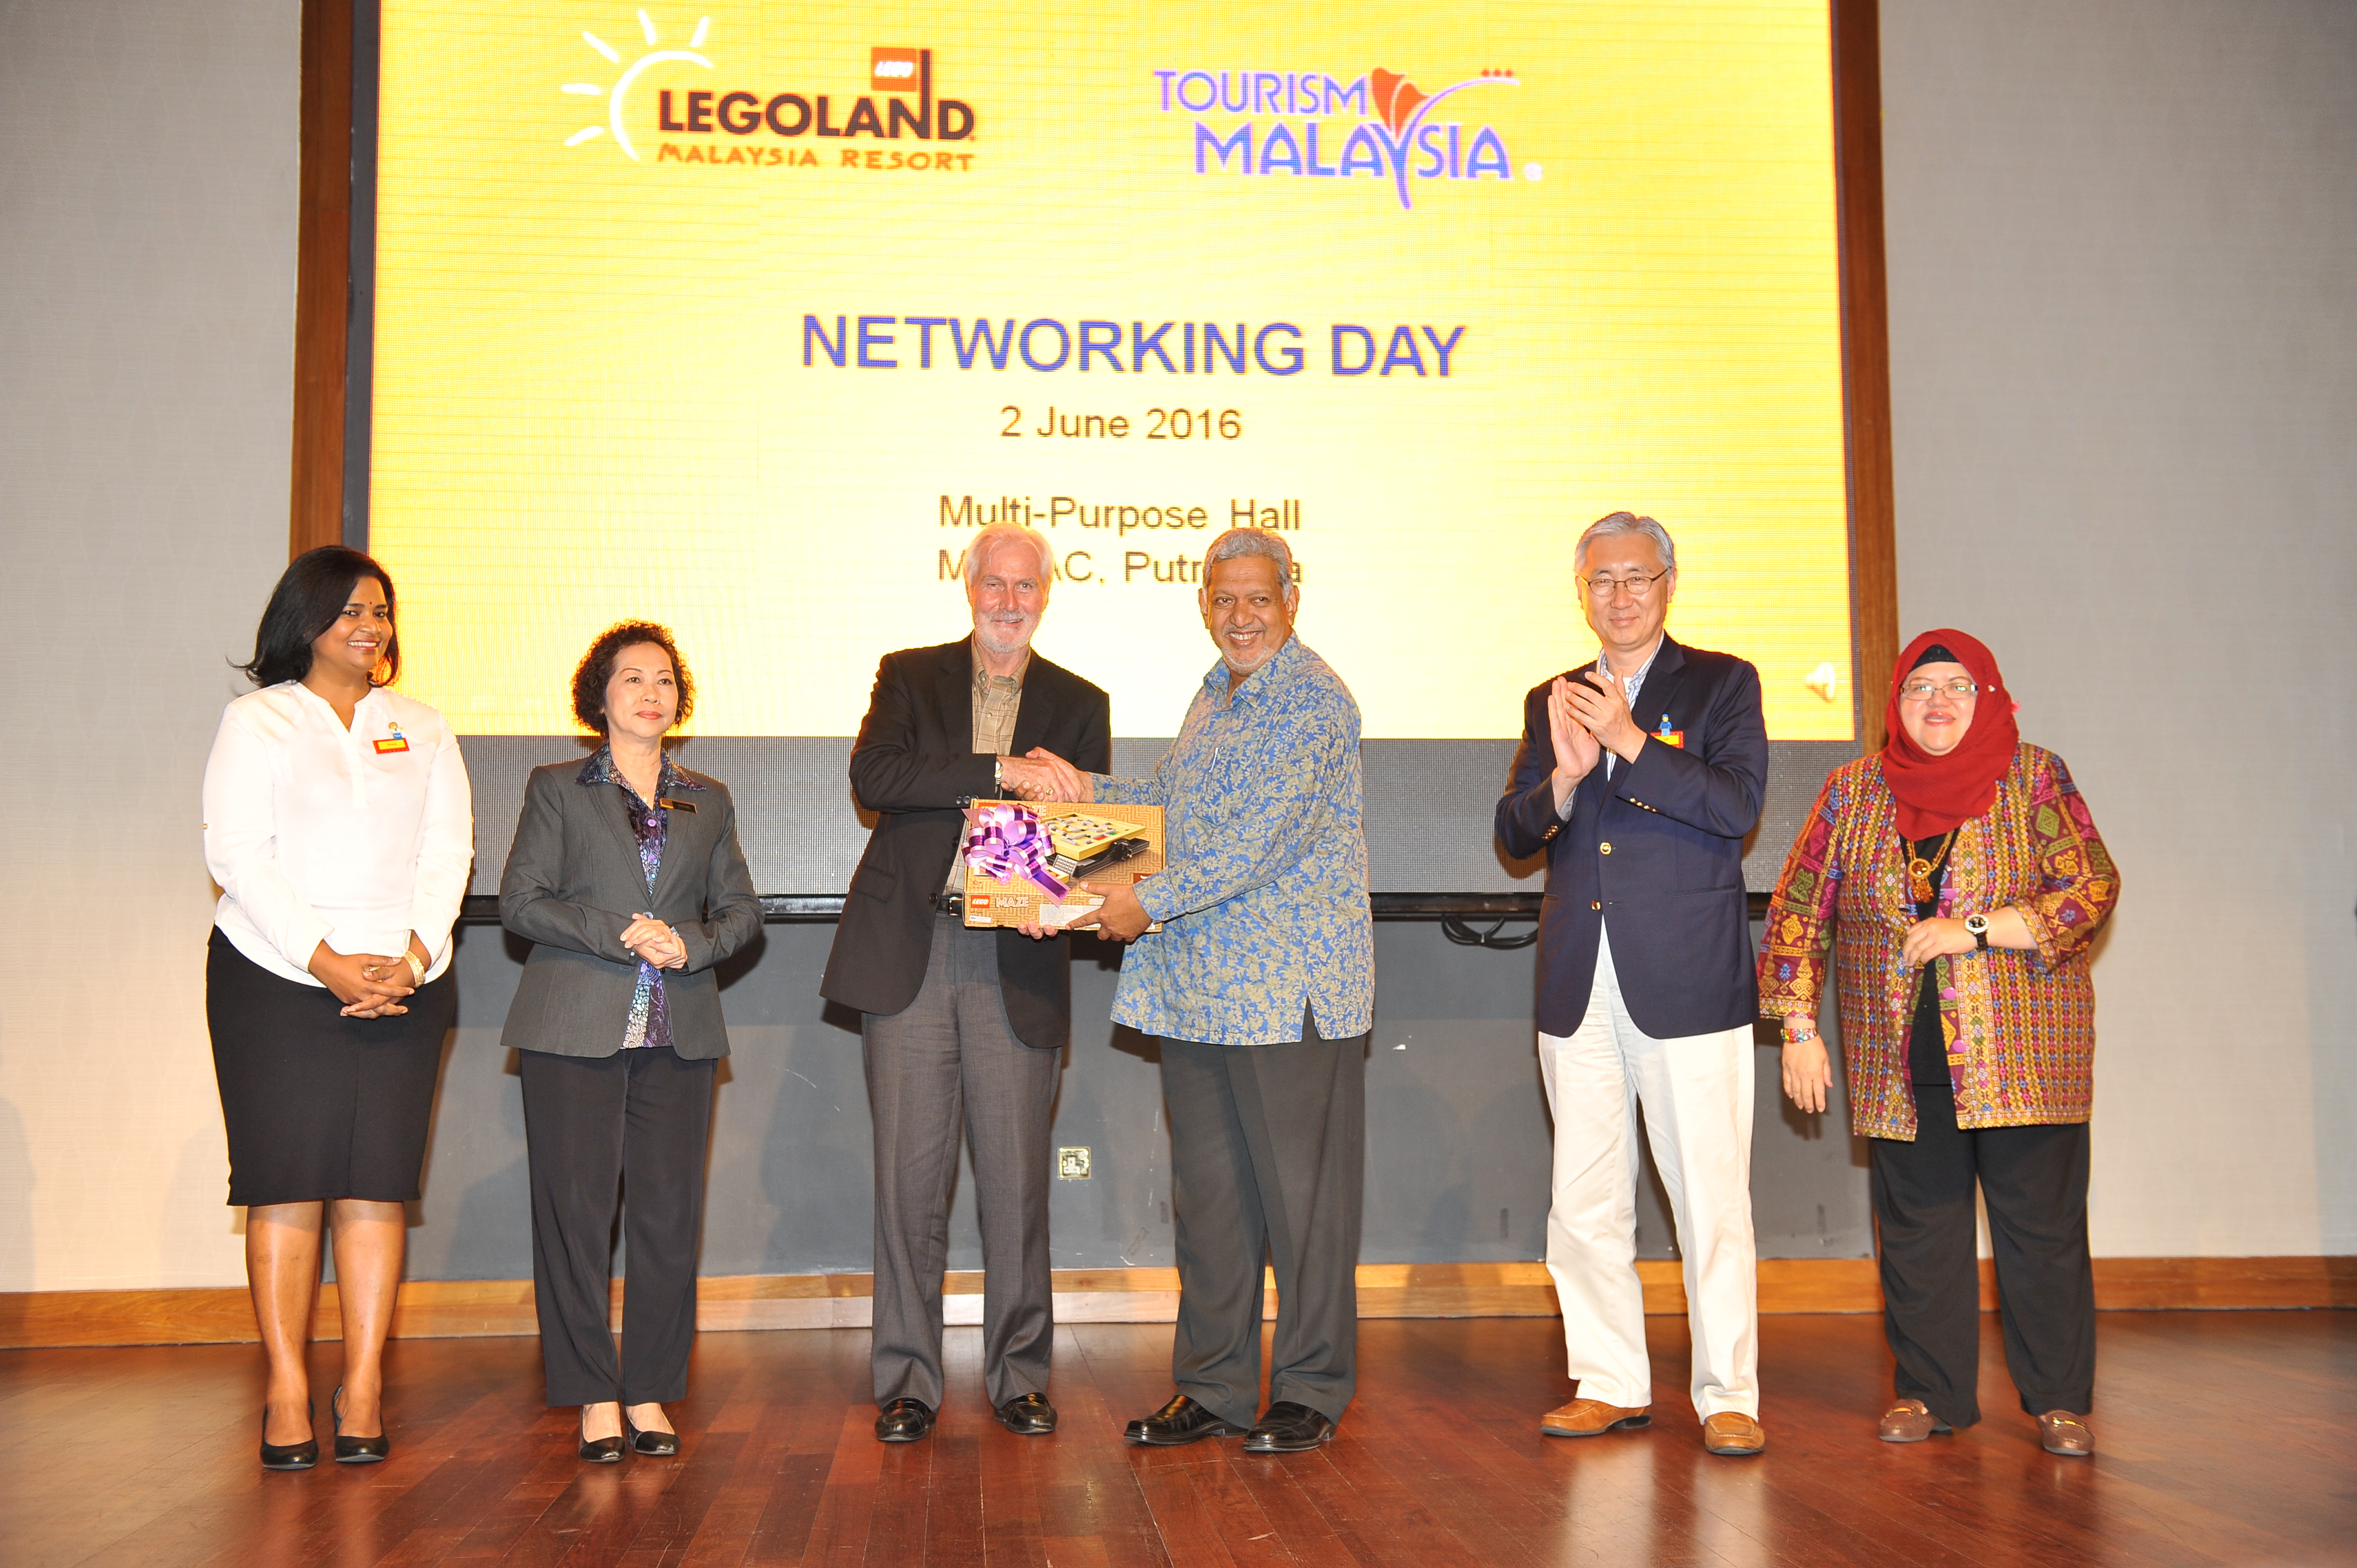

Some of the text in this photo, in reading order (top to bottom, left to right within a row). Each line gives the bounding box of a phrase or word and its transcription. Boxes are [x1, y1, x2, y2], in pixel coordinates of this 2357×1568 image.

[658, 48, 974, 141] LEGOLAND
[1154, 69, 1368, 115] TOURISM
[658, 143, 974, 171] MALAYSIA RESORT
[1195, 120, 1511, 209] MALAYSIA
[802, 314, 1466, 377] NETWORKING DAY
[1001, 405, 1242, 440] 2 June 2016
[940, 495, 1300, 537] Multi-Purpose Hall
[995, 897, 1029, 908] MAZE
